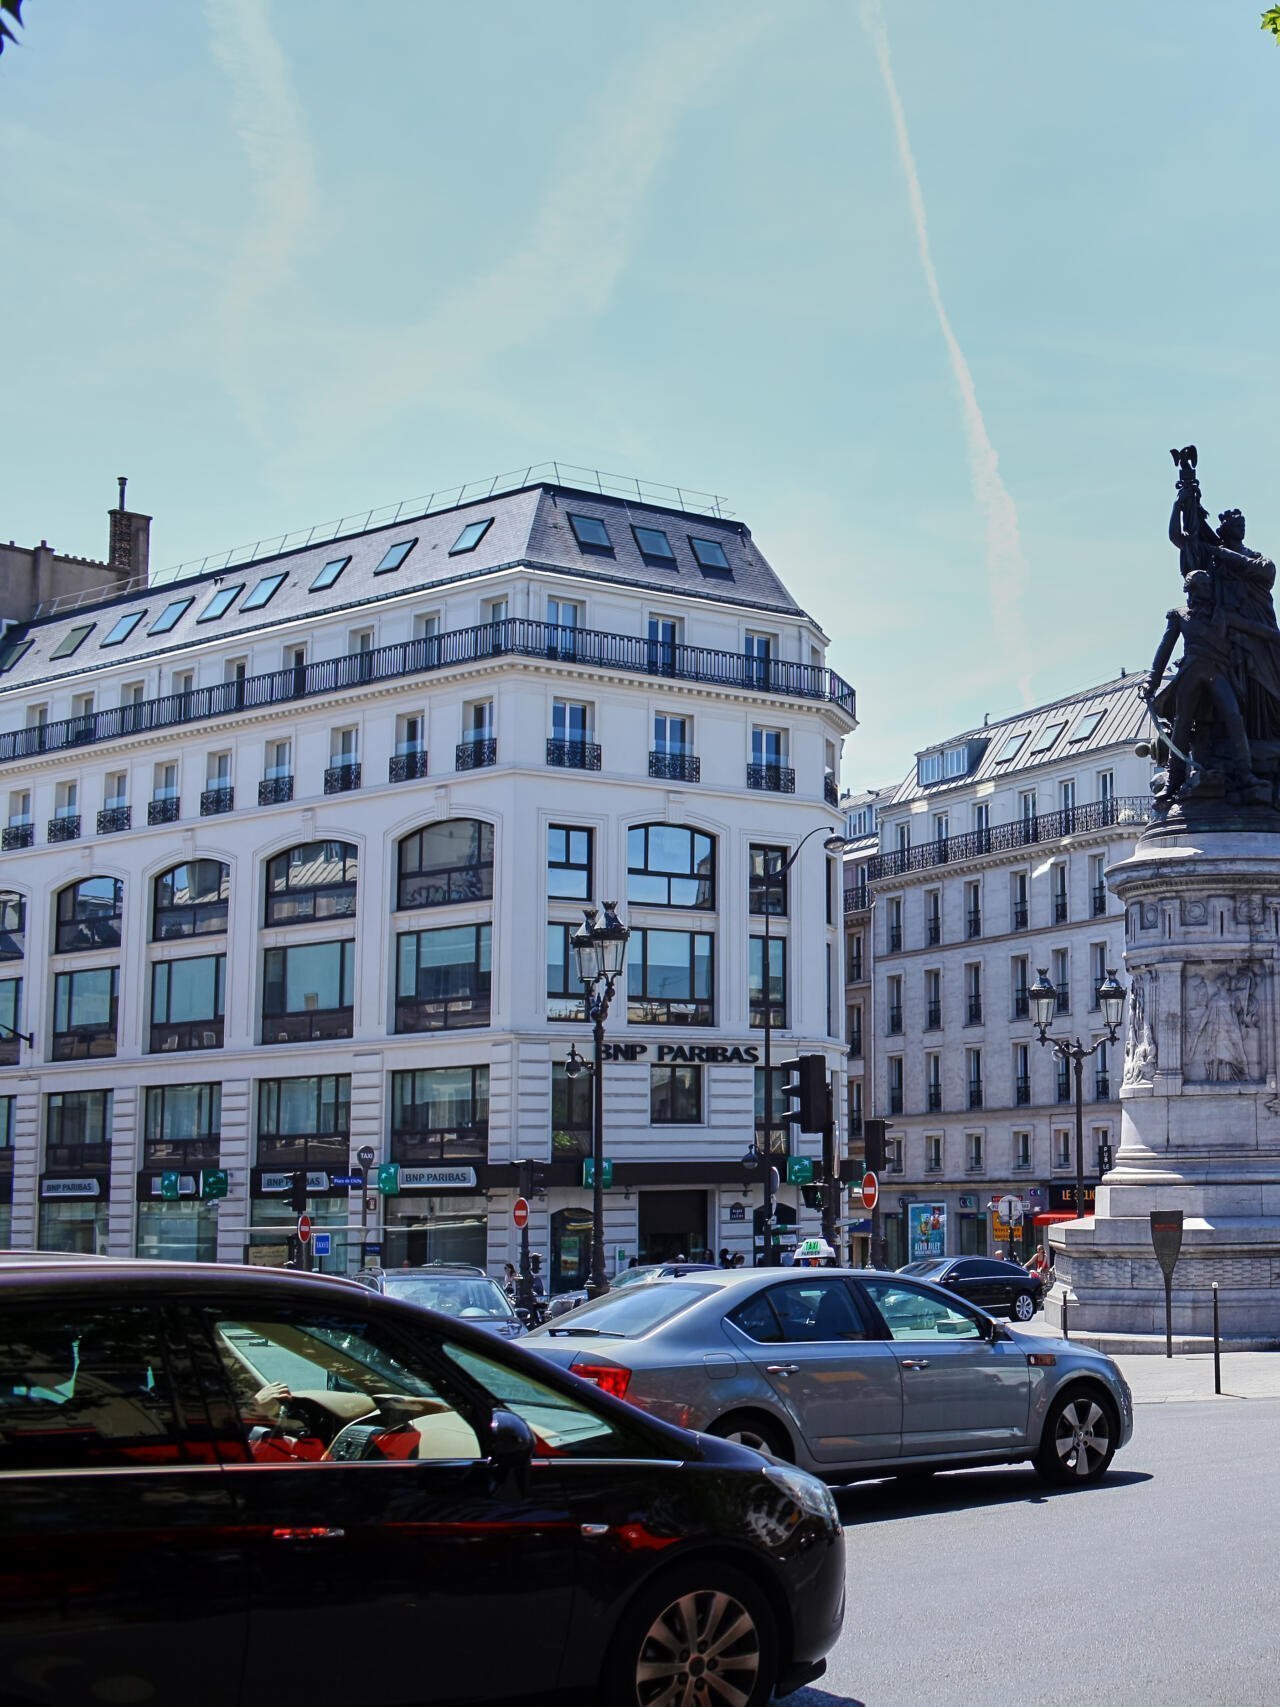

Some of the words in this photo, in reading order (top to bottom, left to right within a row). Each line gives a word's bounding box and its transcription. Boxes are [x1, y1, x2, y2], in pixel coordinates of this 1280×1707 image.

[600, 1043, 648, 1061] BNP
[657, 1044, 760, 1063] PARIBAS
[406, 1173, 425, 1182] BNP
[426, 1172, 467, 1181] PARIBAS
[266, 1178, 284, 1187] BNP
[46, 1184, 61, 1192] BNP
[62, 1183, 92, 1191] PARIBAS
[1062, 1190, 1071, 1200] LE
[806, 1241, 820, 1250] TAXI
